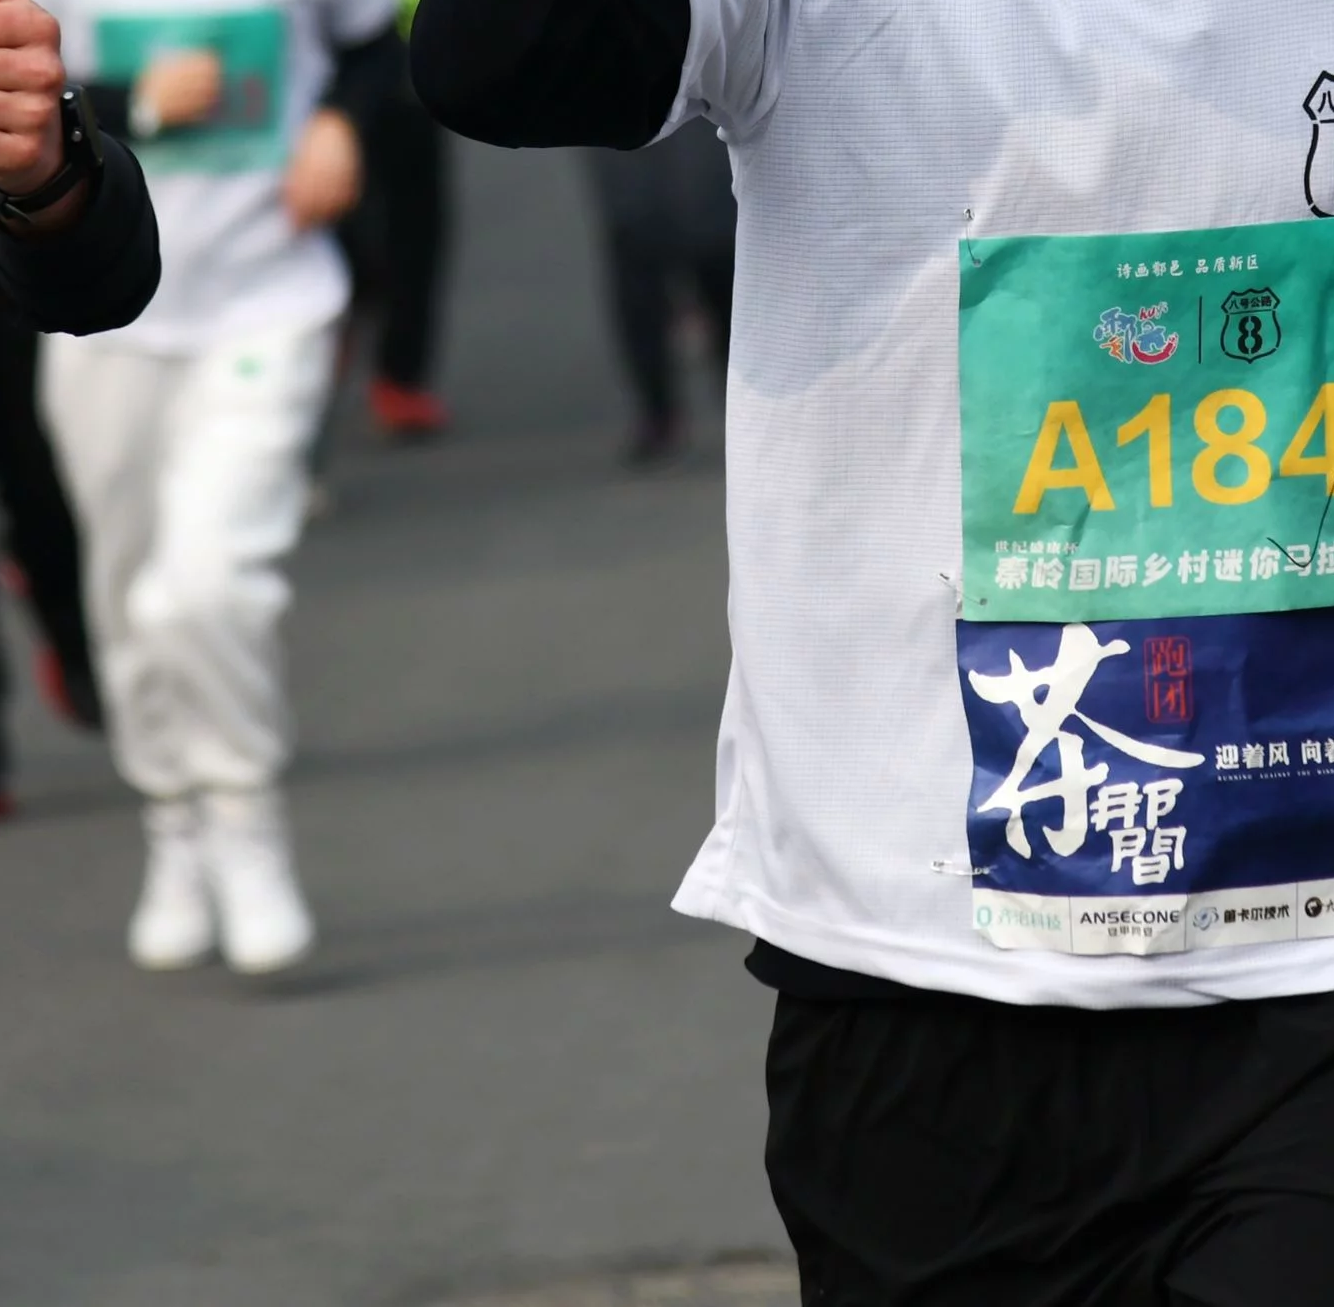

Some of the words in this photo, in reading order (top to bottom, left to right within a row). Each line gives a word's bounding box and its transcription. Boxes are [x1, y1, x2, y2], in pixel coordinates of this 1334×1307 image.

[1195, 254, 1259, 274] 品质新区
[1237, 315, 1263, 355] 8
[1216, 741, 1290, 770] 迎着风
[1080, 910, 1181, 924] ANSECONE
